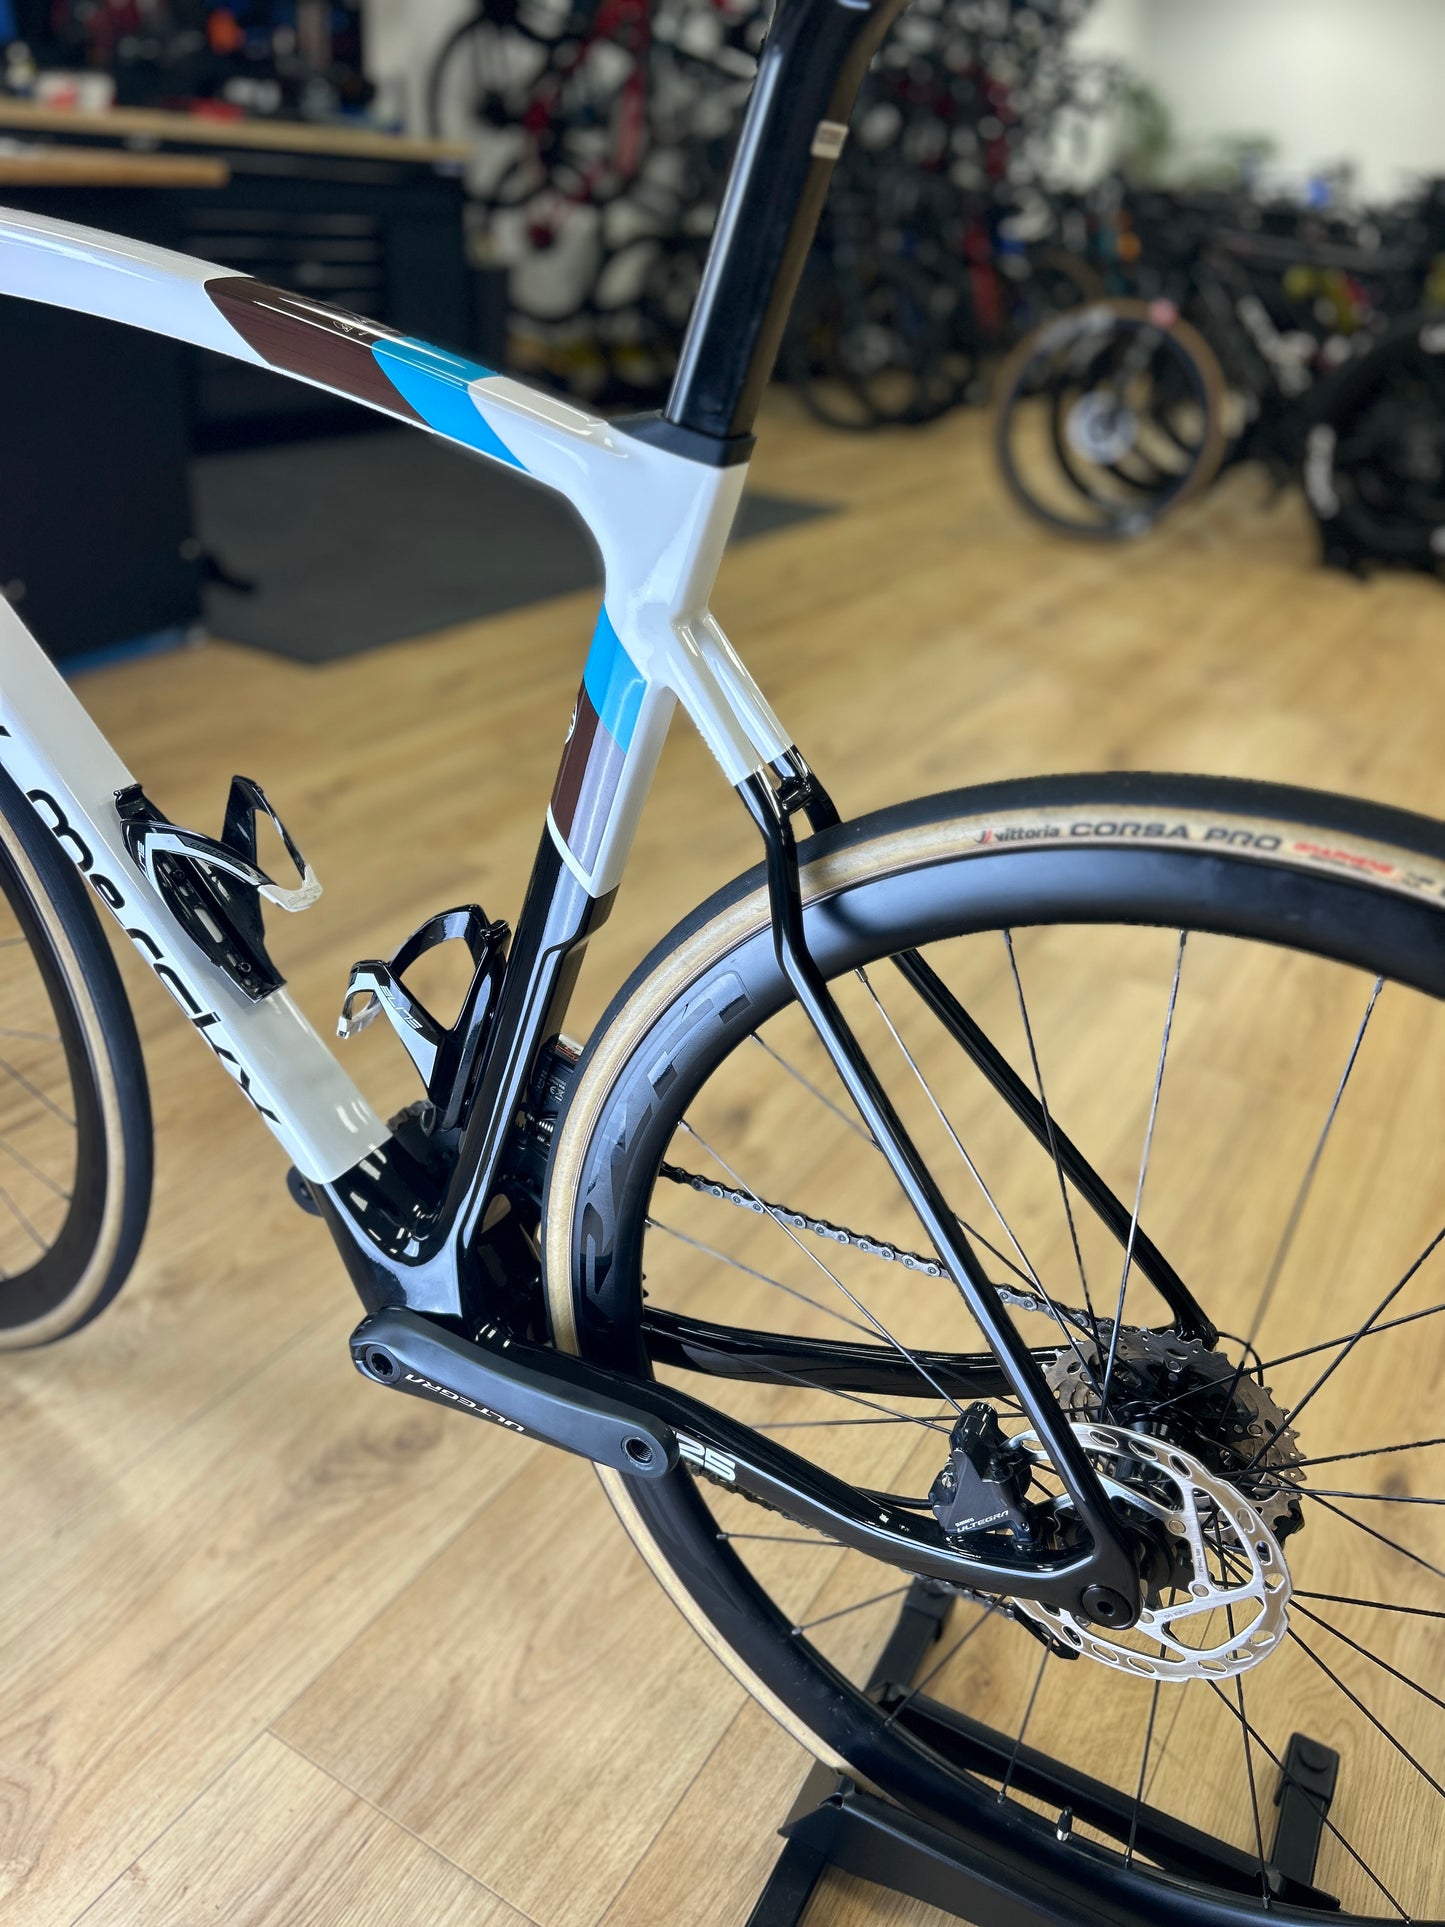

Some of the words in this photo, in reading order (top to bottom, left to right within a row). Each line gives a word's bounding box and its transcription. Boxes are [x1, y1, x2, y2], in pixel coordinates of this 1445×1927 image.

[994, 825, 1060, 842] vittoria
[1069, 821, 1189, 839] CORSA
[1203, 827, 1282, 850] PRO
[404, 1373, 525, 1432] ULTEGRA
[673, 1430, 736, 1482] 25
[956, 1509, 1010, 1533] ULTEGRA
